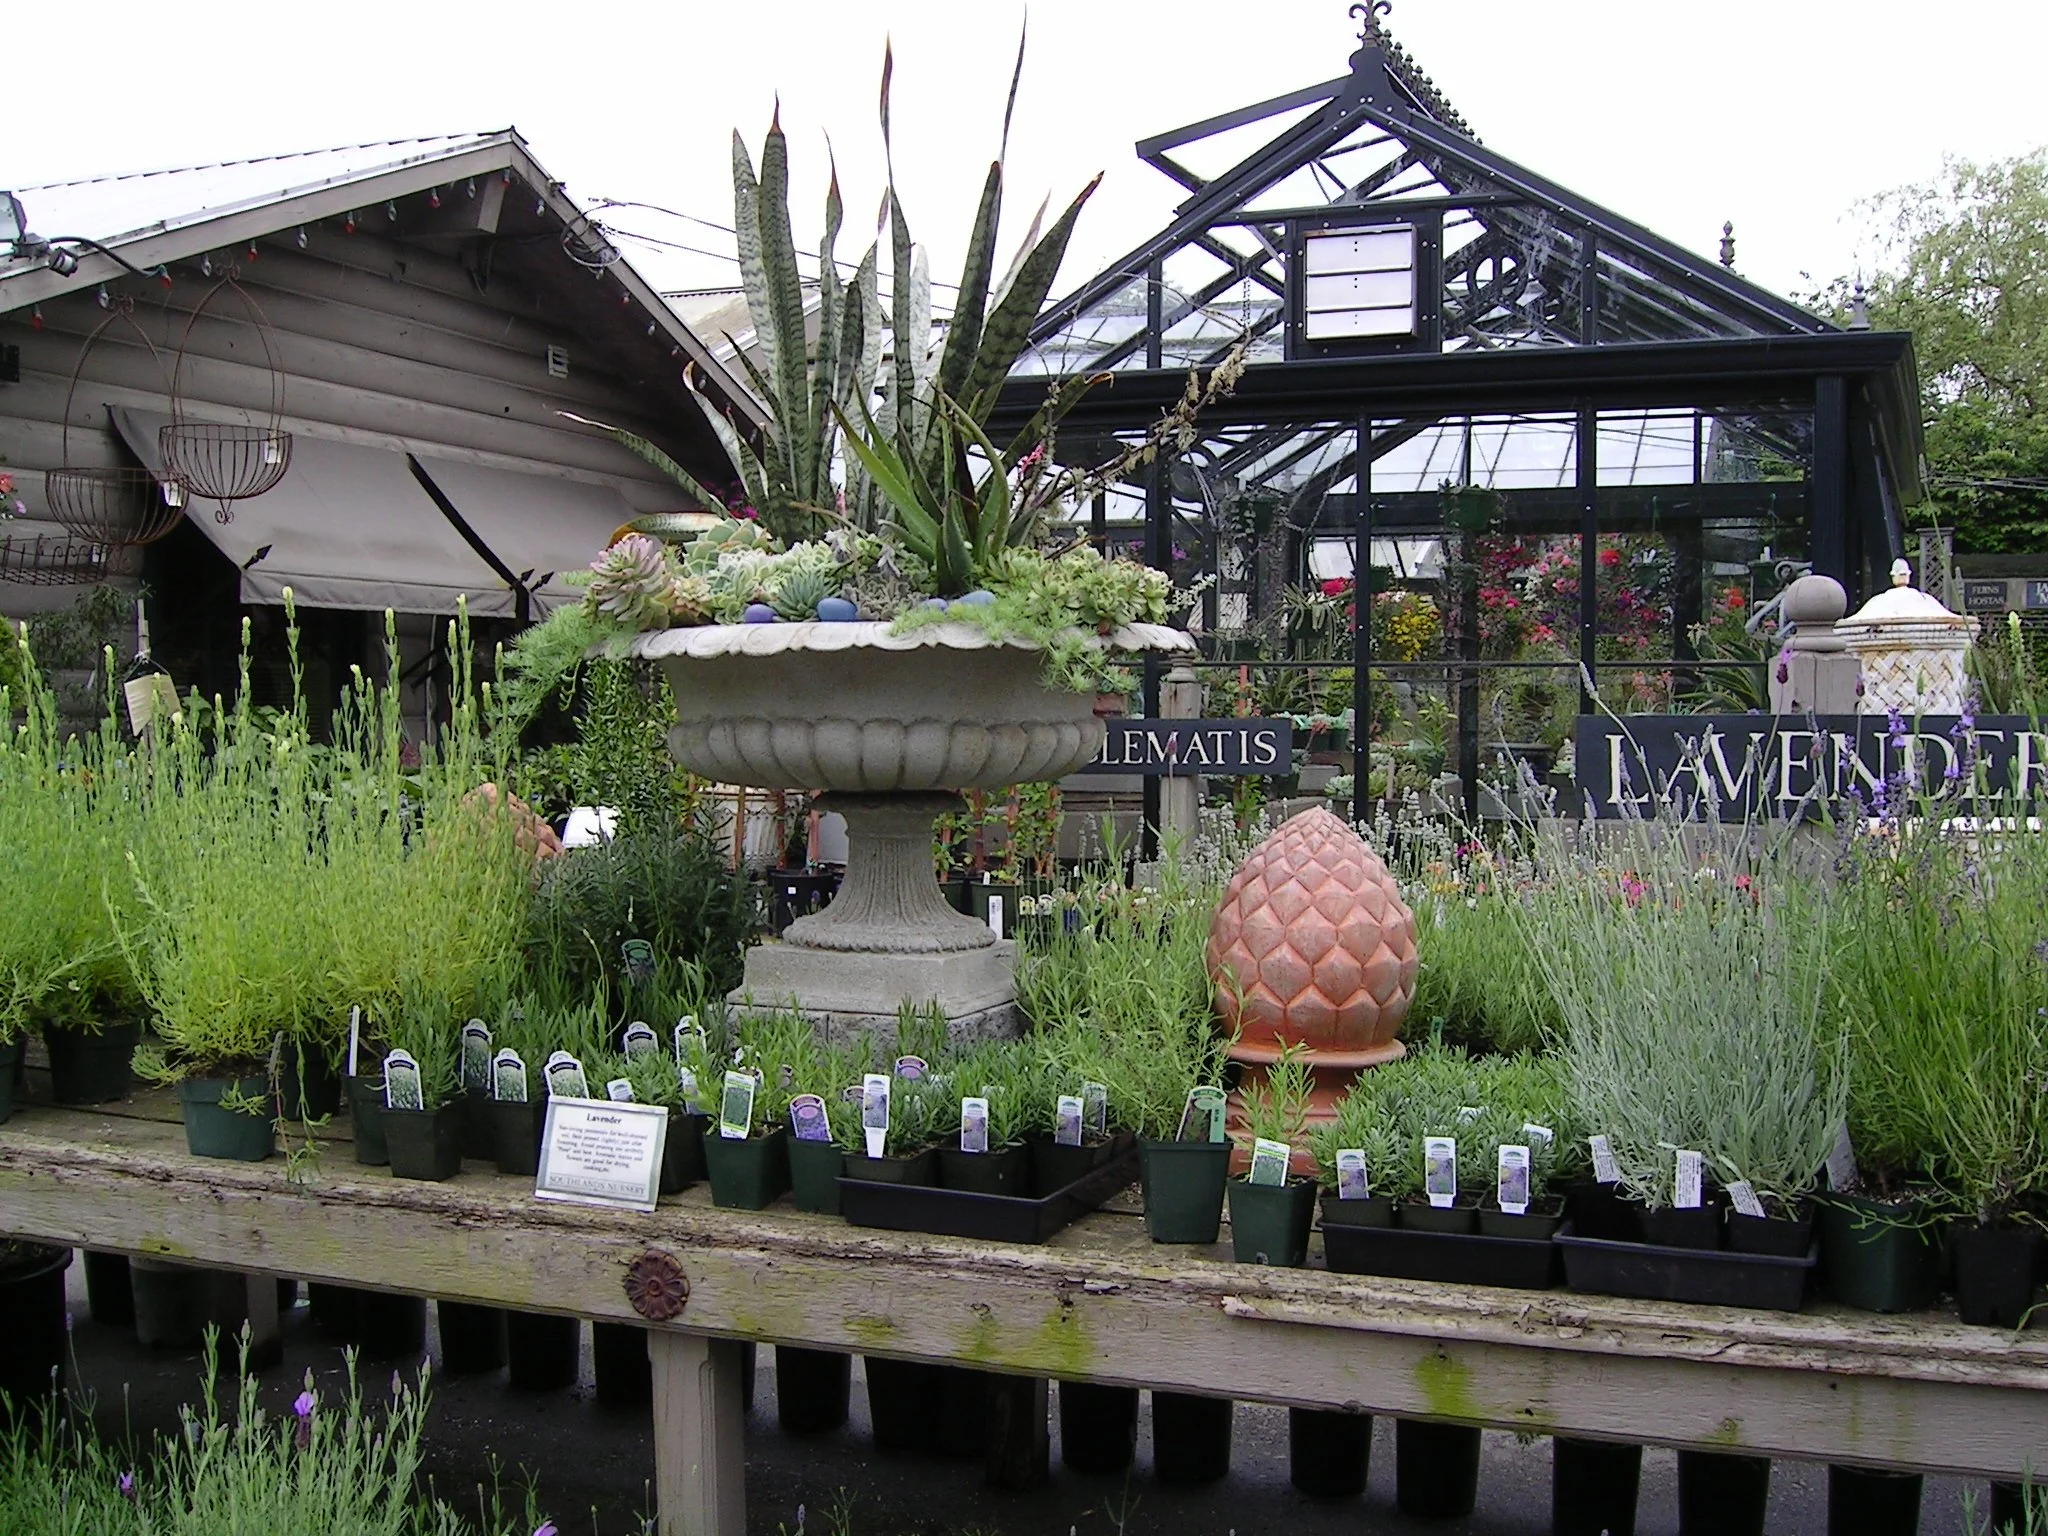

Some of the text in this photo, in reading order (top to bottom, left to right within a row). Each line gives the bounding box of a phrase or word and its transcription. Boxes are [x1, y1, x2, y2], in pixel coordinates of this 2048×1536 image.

[1968, 597, 2004, 605] HOSTAS
[1087, 730, 1277, 765] LEMATIS
[586, 1113, 622, 1125] Lavender
[549, 1175, 645, 1195] SOUTHLANDS NURSERY
